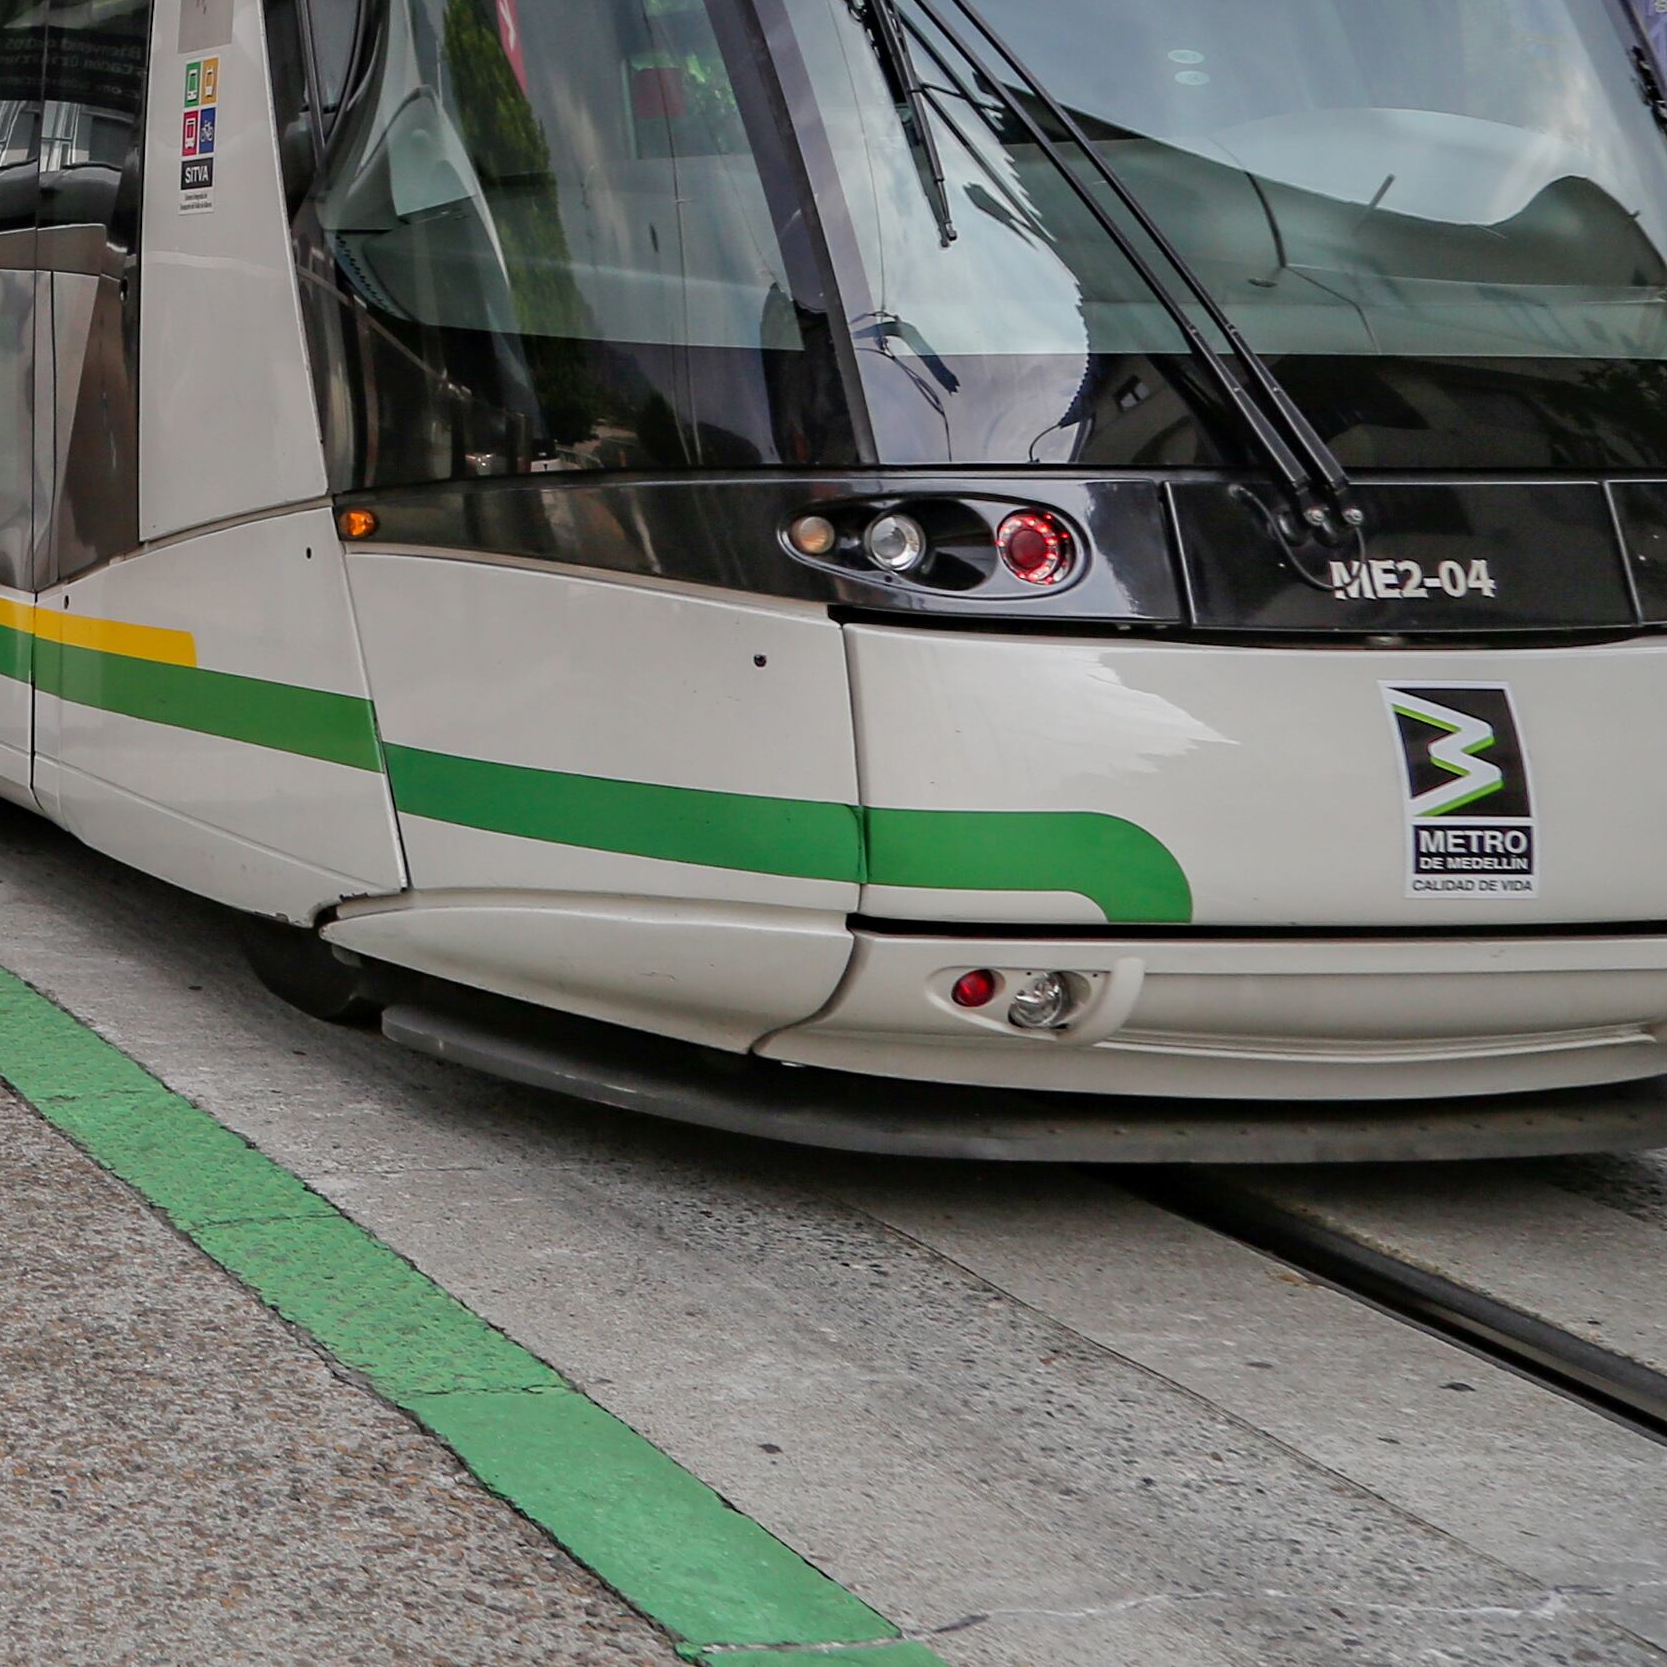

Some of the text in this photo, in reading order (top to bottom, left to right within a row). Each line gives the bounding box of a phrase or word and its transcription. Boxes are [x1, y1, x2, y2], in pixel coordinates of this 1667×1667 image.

[1330, 558, 1496, 600] ME2-04
[1419, 830, 1528, 855] METRO
[1419, 857, 1445, 870] DE
[1412, 879, 1532, 892] CALIDAD DE VIDA
